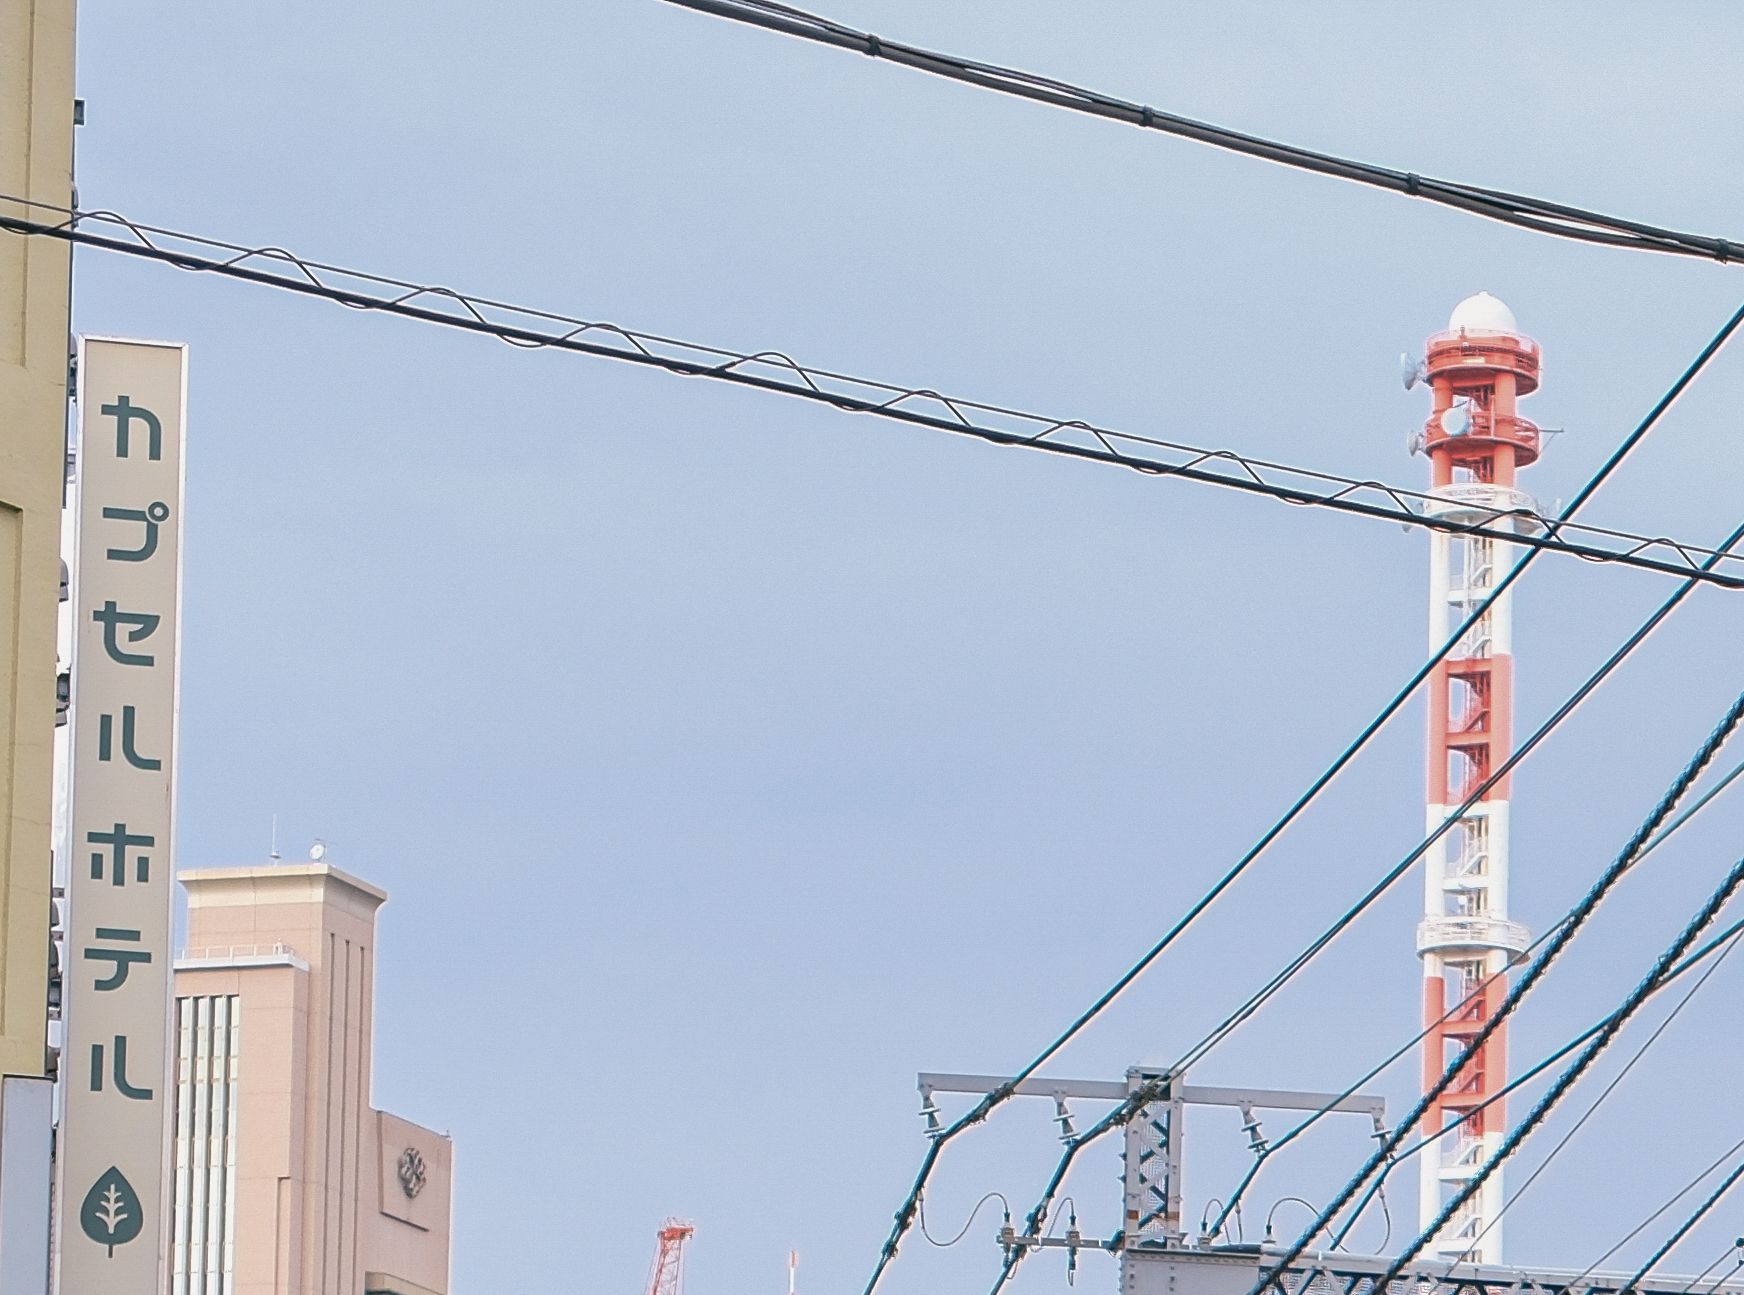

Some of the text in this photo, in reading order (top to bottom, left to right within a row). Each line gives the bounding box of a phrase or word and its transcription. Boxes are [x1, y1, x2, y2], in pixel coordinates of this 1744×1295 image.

[84, 394, 171, 1102] カプセルホテル
